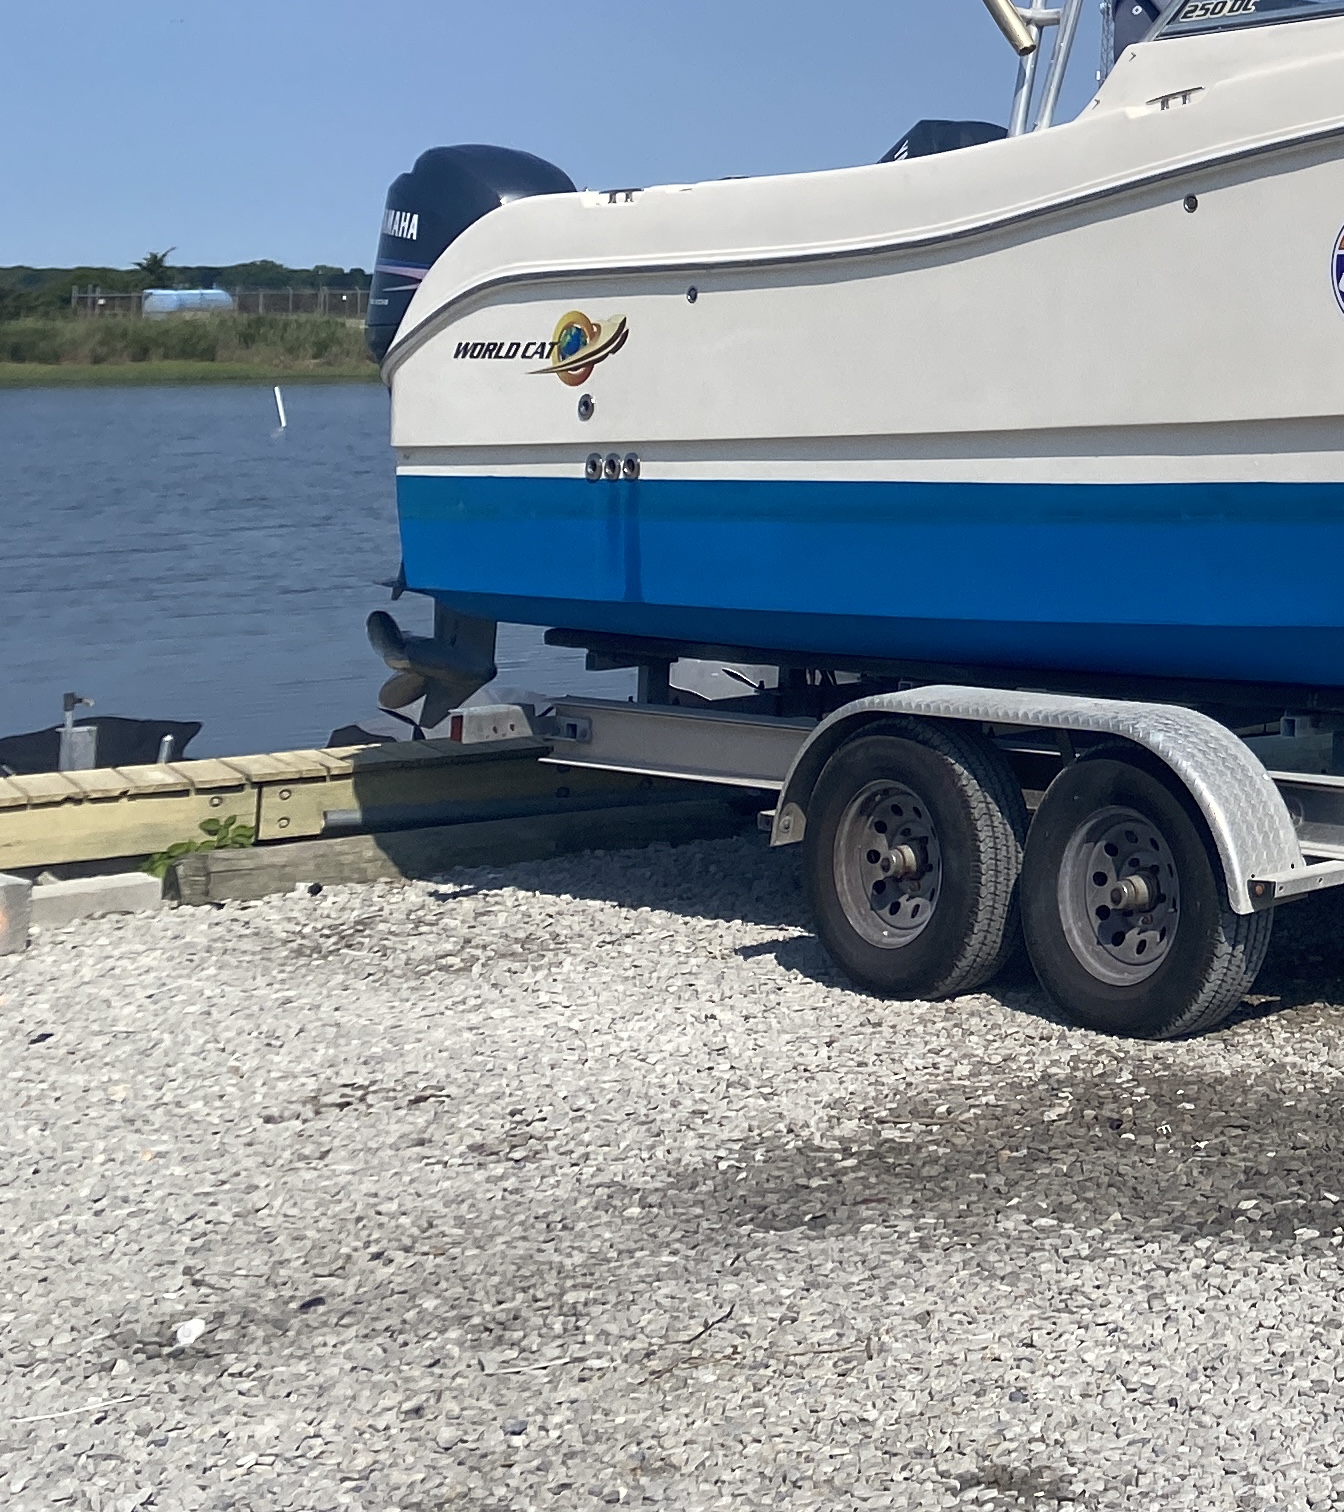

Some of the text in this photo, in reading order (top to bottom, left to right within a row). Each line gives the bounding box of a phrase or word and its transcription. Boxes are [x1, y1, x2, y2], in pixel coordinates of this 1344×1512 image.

[1180, 0, 1227, 21] 250
[453, 341, 560, 360] WORLD CAT
